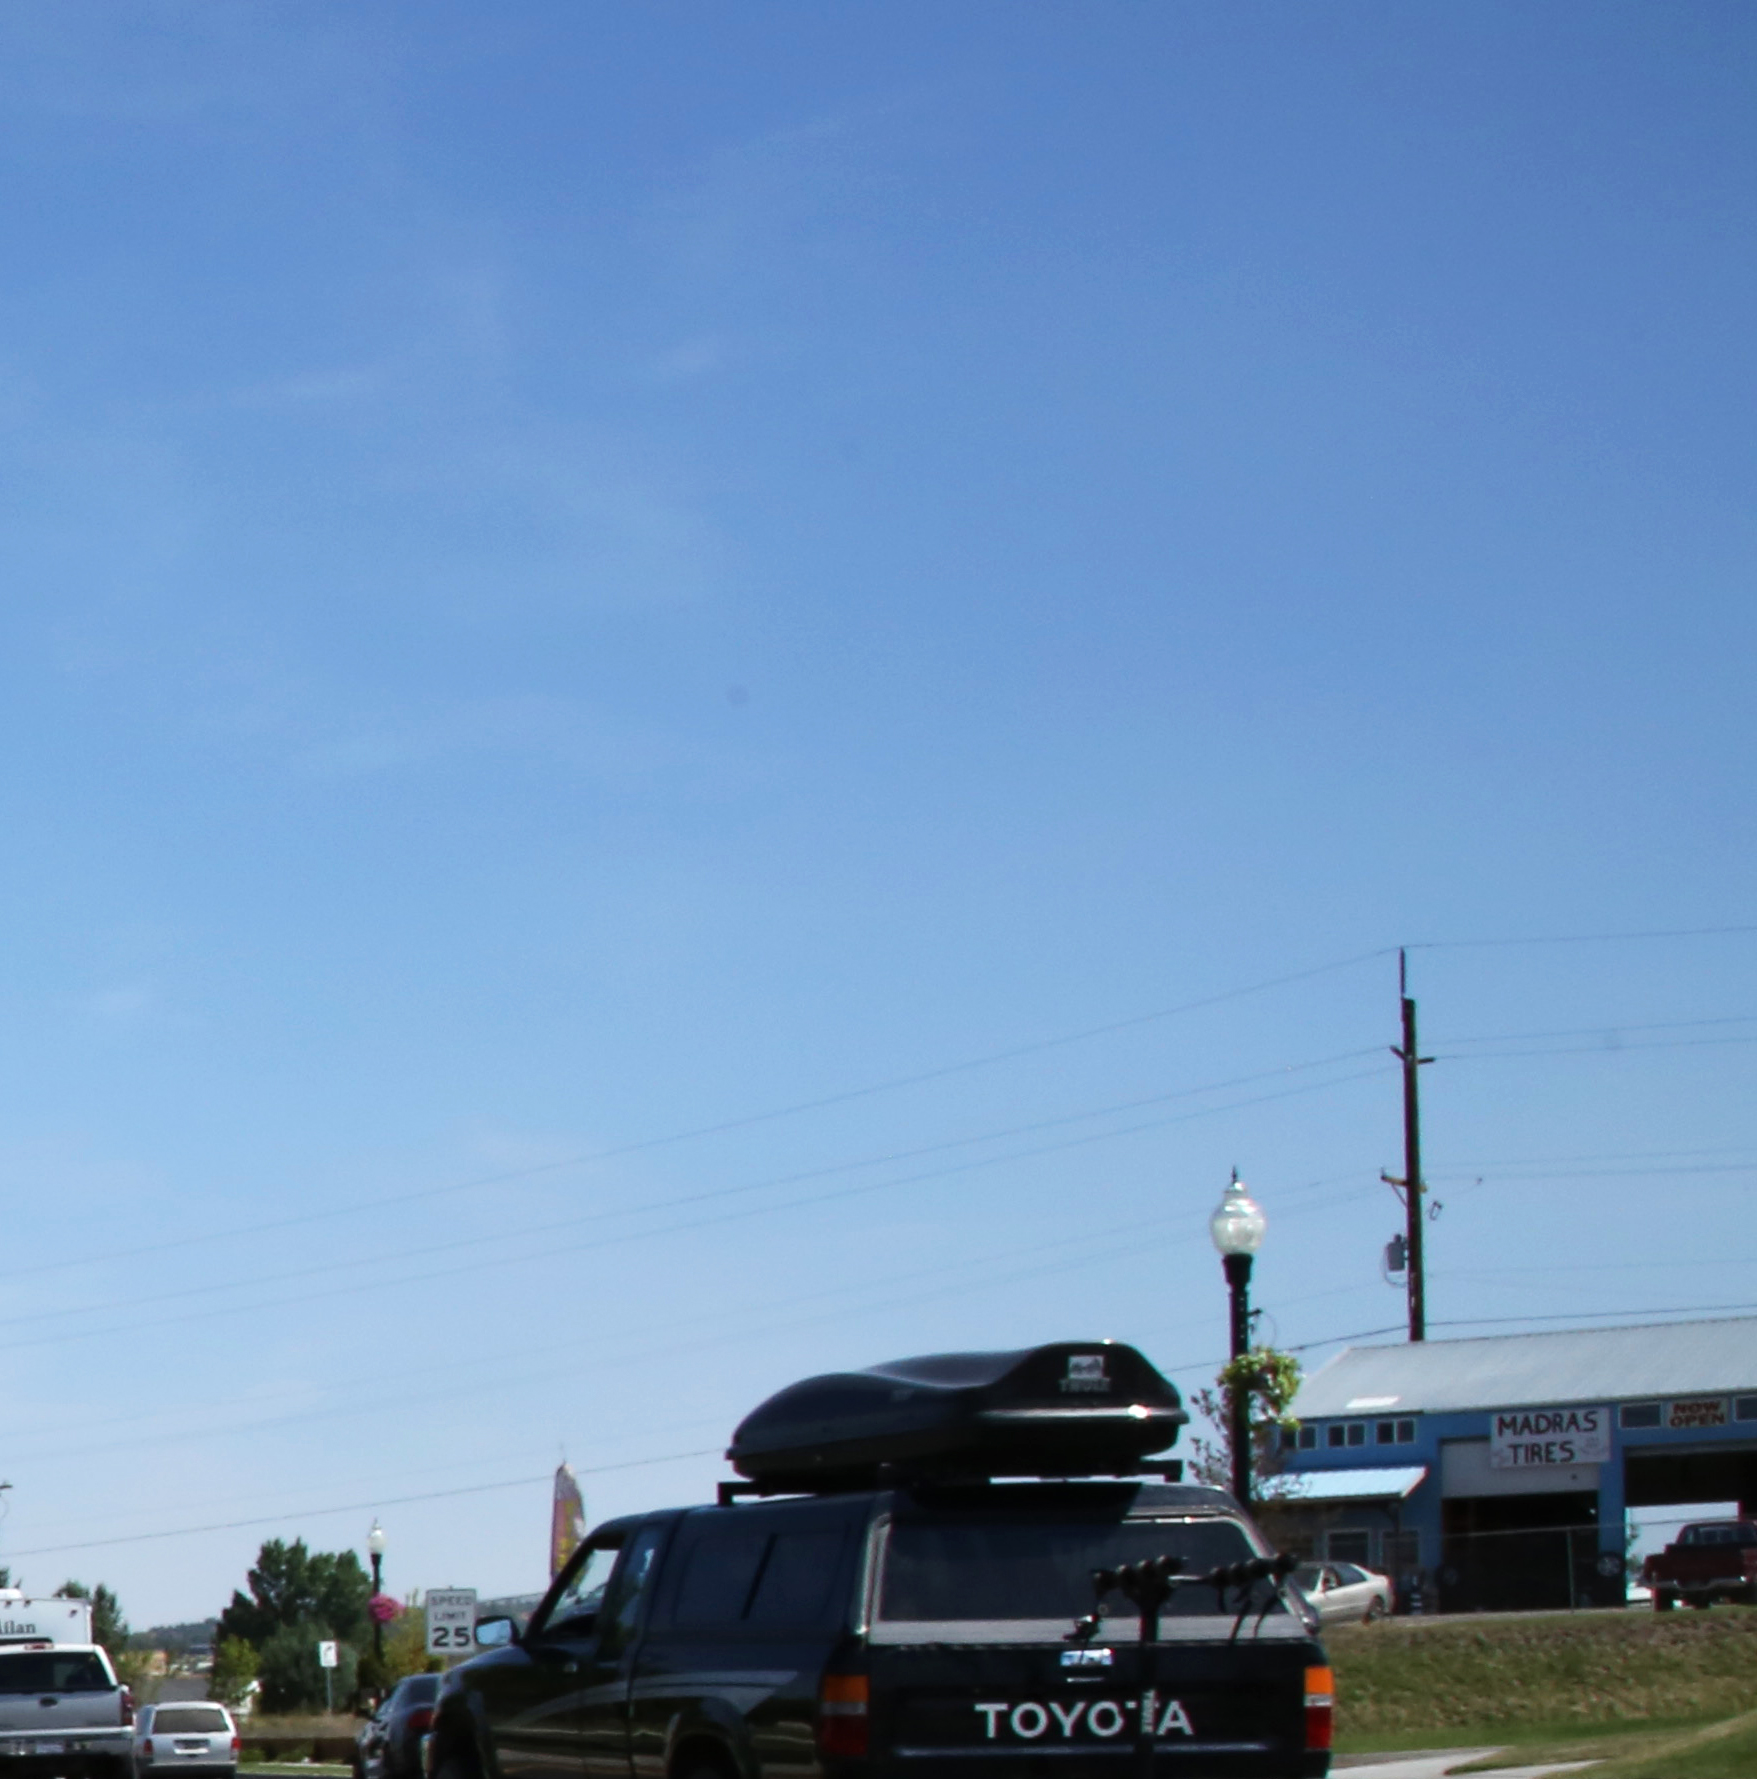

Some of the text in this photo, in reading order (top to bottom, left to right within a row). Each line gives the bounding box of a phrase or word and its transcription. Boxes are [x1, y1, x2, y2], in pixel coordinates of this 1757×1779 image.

[1673, 1402, 1721, 1414] NOW
[1497, 1411, 1599, 1437] MADRAS
[1669, 1413, 1725, 1428] OPEN
[1507, 1440, 1575, 1465] TIRES
[430, 1596, 471, 1605] SPEED
[434, 1611, 466, 1620] LIMIT
[432, 1626, 470, 1647] 25
[975, 1701, 1193, 1738] TOYOA
